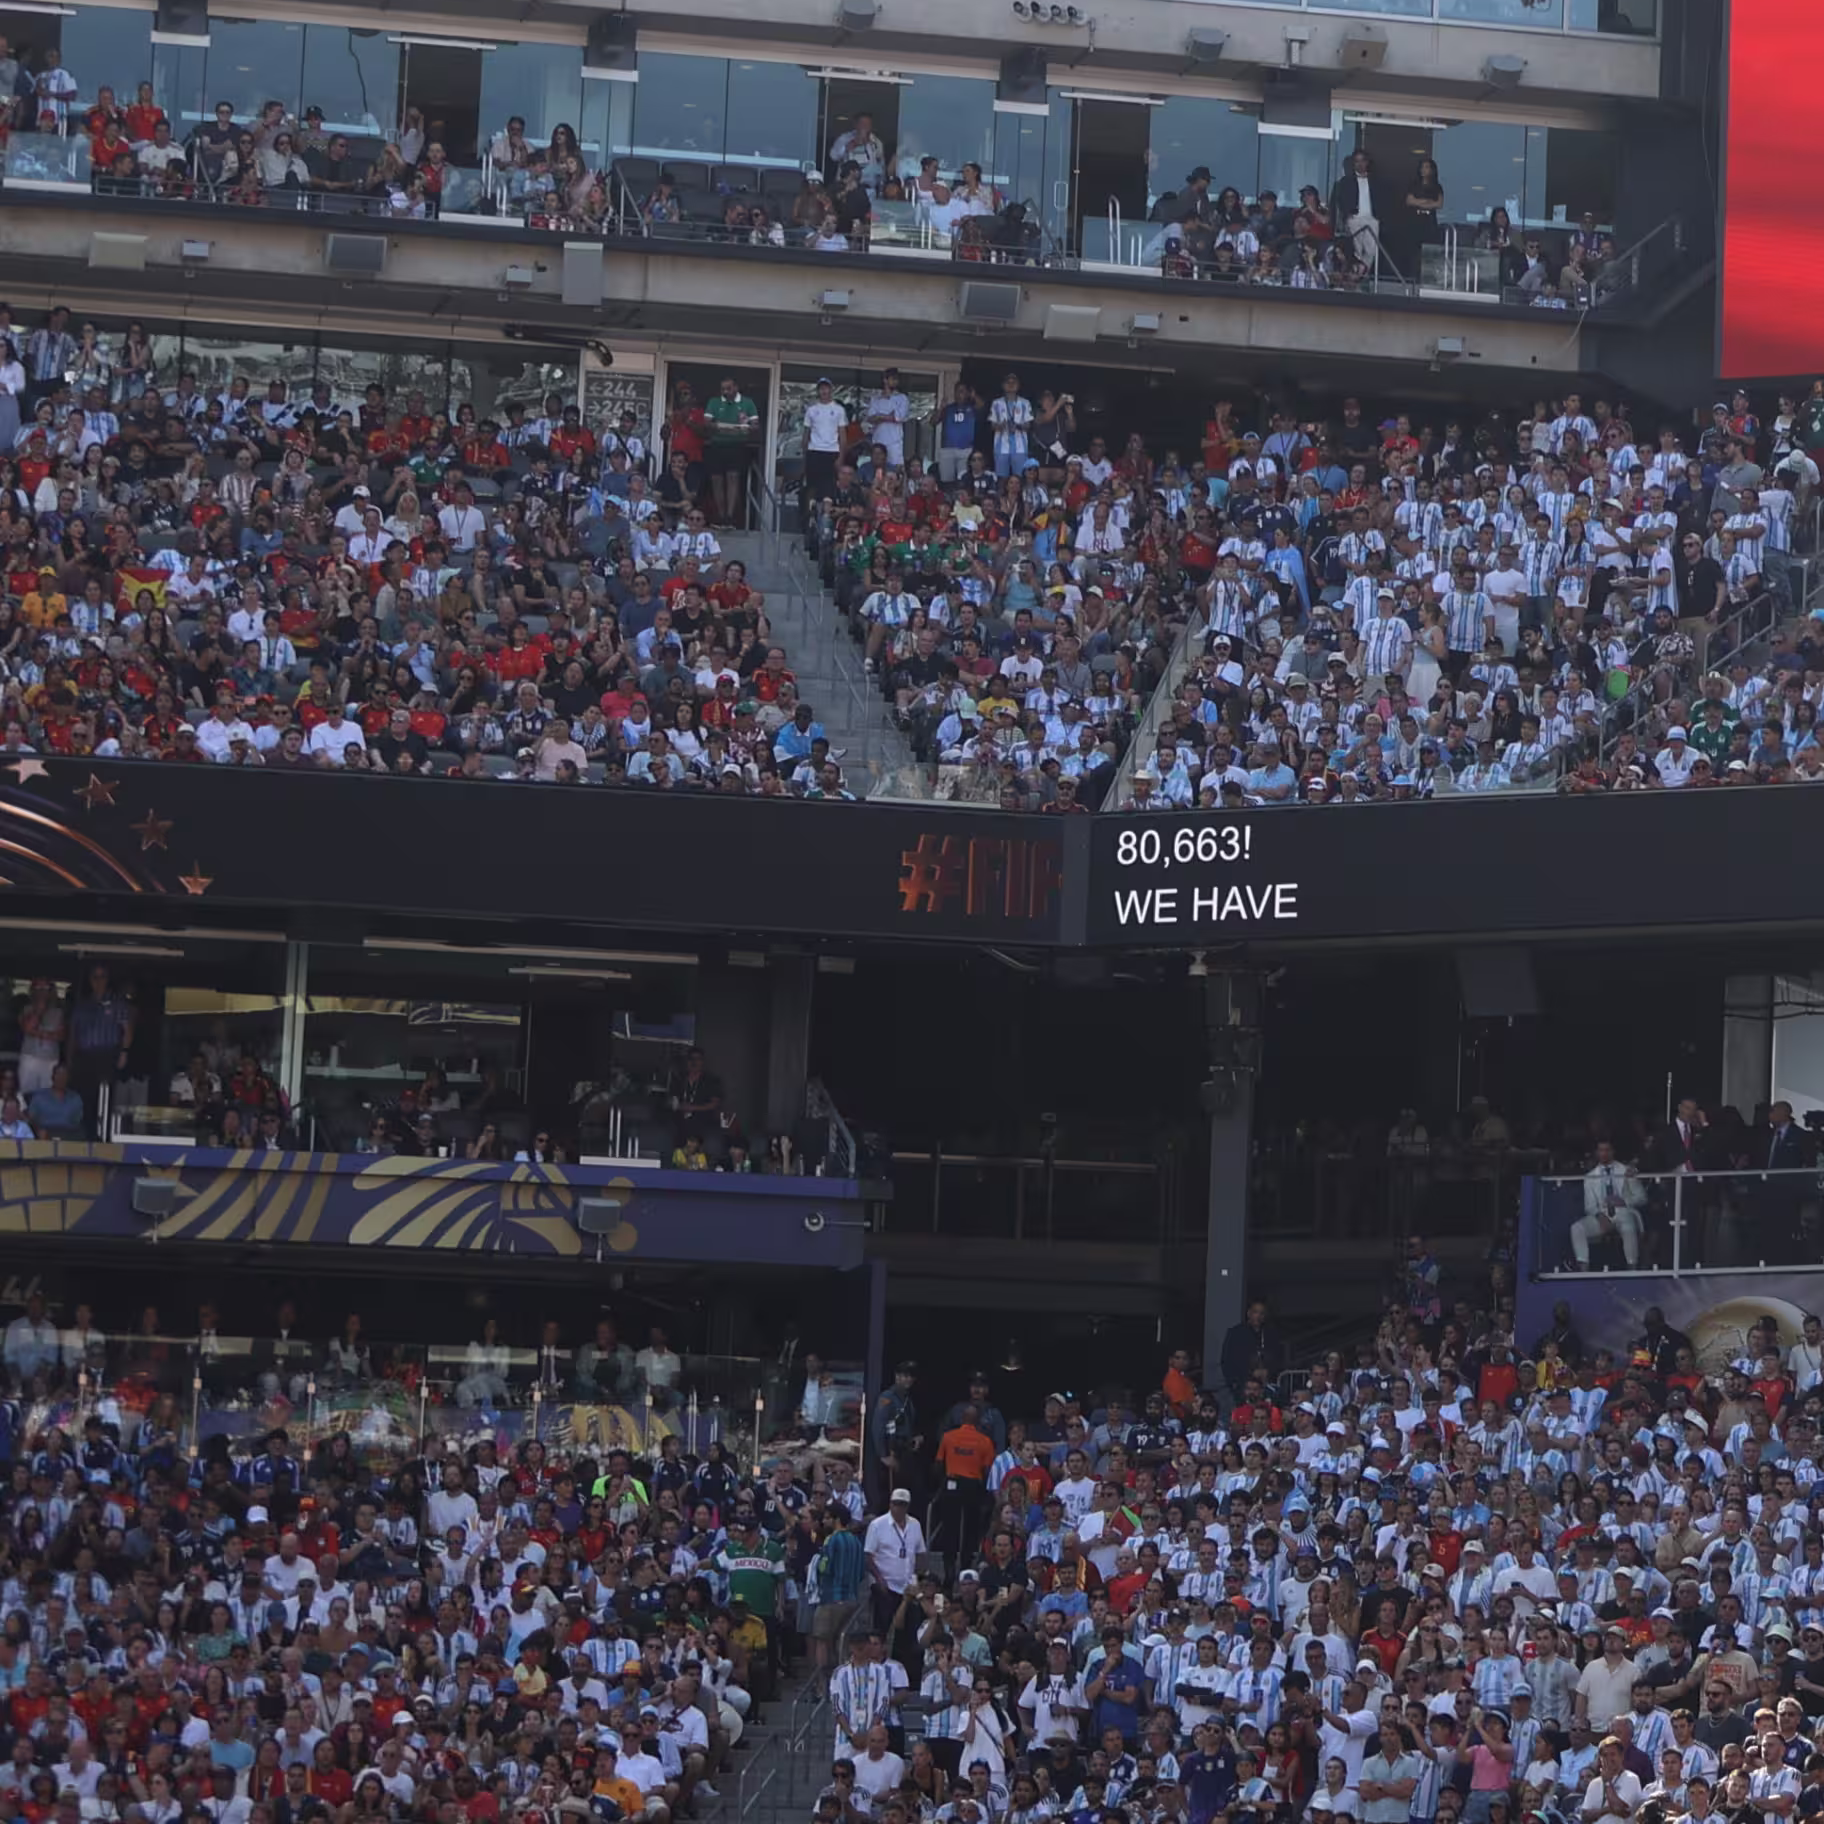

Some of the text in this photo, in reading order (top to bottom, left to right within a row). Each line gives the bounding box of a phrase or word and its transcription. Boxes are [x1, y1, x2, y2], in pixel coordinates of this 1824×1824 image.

[603, 382, 636, 397] 244
[1117, 825, 1251, 868] 80,663!
[1115, 883, 1298, 924] WE HAVE
